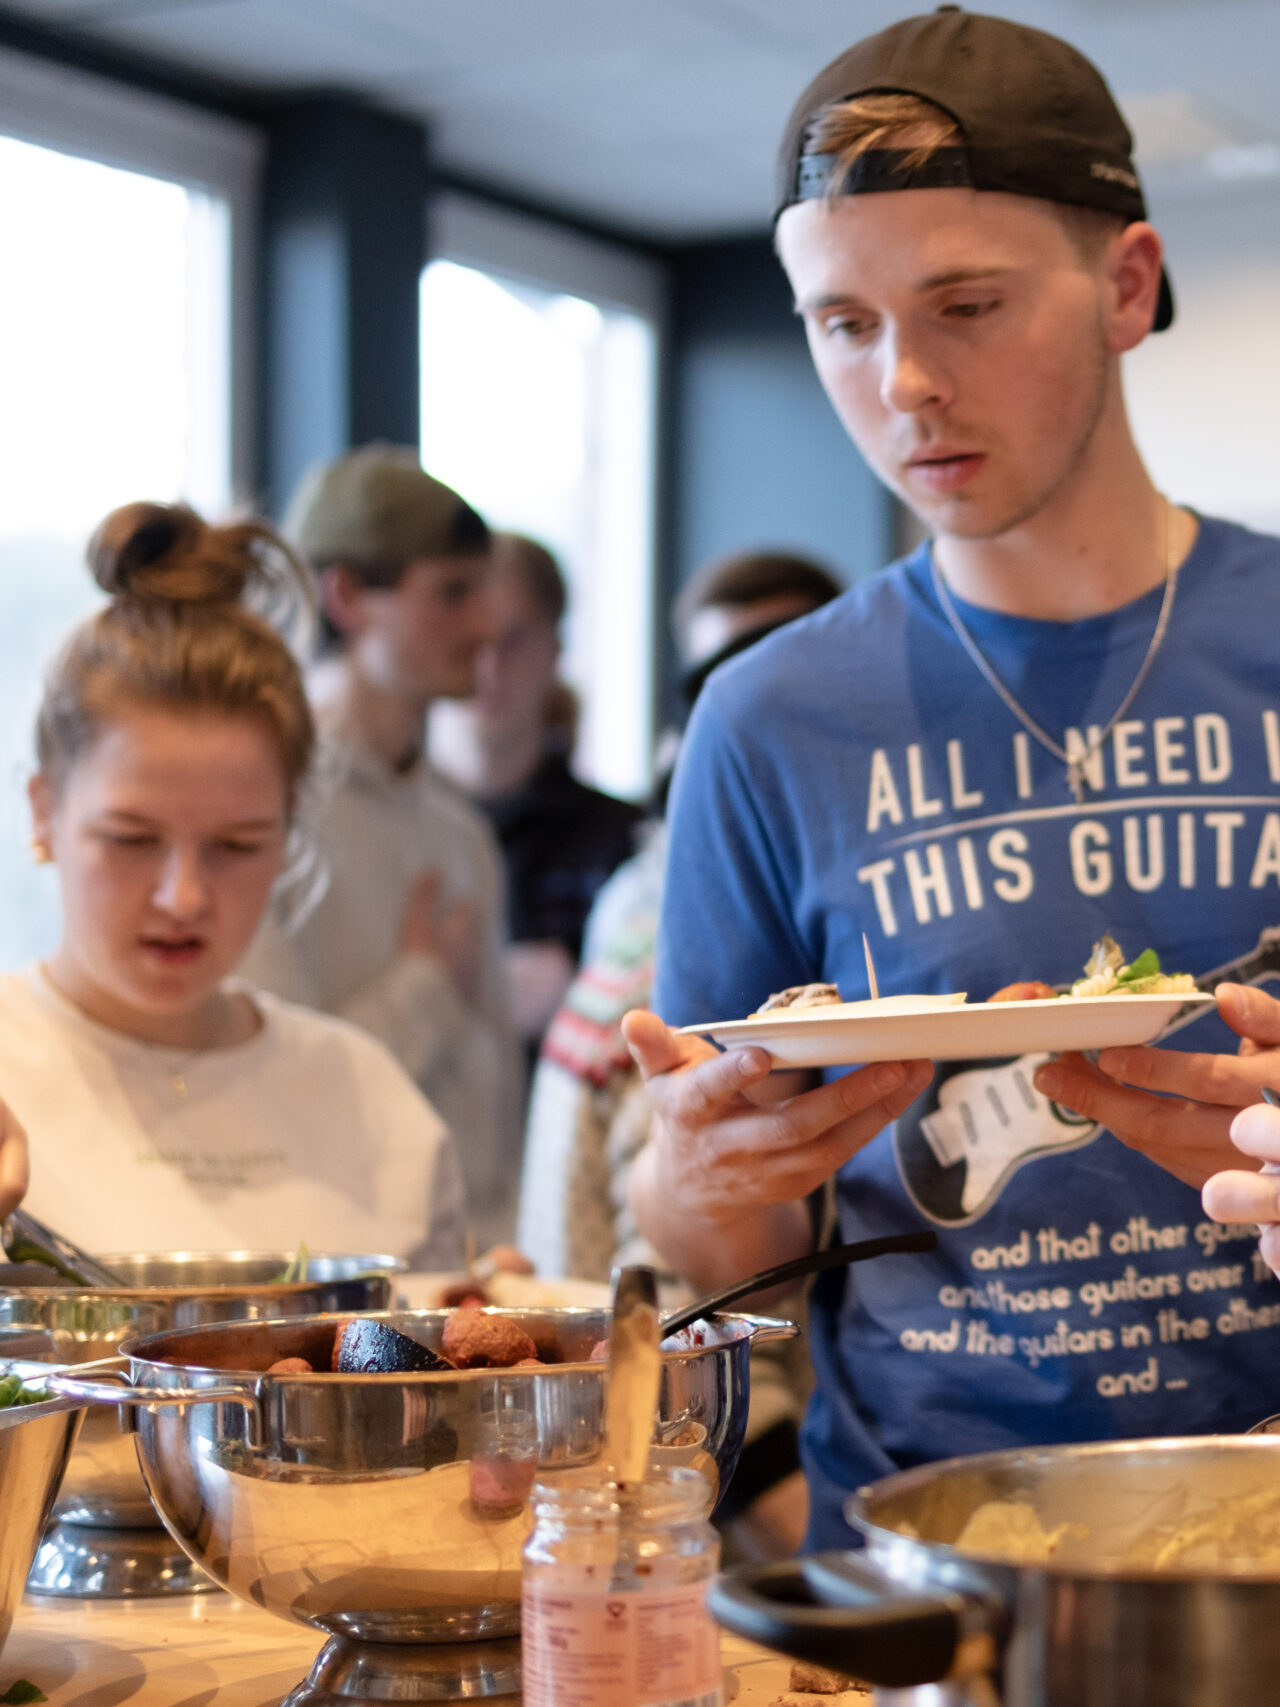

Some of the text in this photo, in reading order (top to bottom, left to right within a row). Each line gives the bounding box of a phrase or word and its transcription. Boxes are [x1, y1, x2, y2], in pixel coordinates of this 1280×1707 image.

[867, 740, 983, 832] ALL
[1014, 732, 1032, 798] I
[1065, 714, 1232, 791] NEED
[858, 829, 1034, 937] THIS
[971, 1230, 1030, 1270] and
[1037, 1222, 1101, 1263] that
[1110, 1217, 1188, 1254] other
[987, 1280, 1071, 1314] those
[1080, 1266, 1182, 1317] guitars
[1186, 1264, 1244, 1293] over
[900, 1319, 960, 1352] and
[966, 1320, 1015, 1356] the
[1018, 1319, 1114, 1368] guitars
[1121, 1325, 1152, 1347] in
[1156, 1308, 1209, 1343] the
[1097, 1357, 1159, 1397] and
